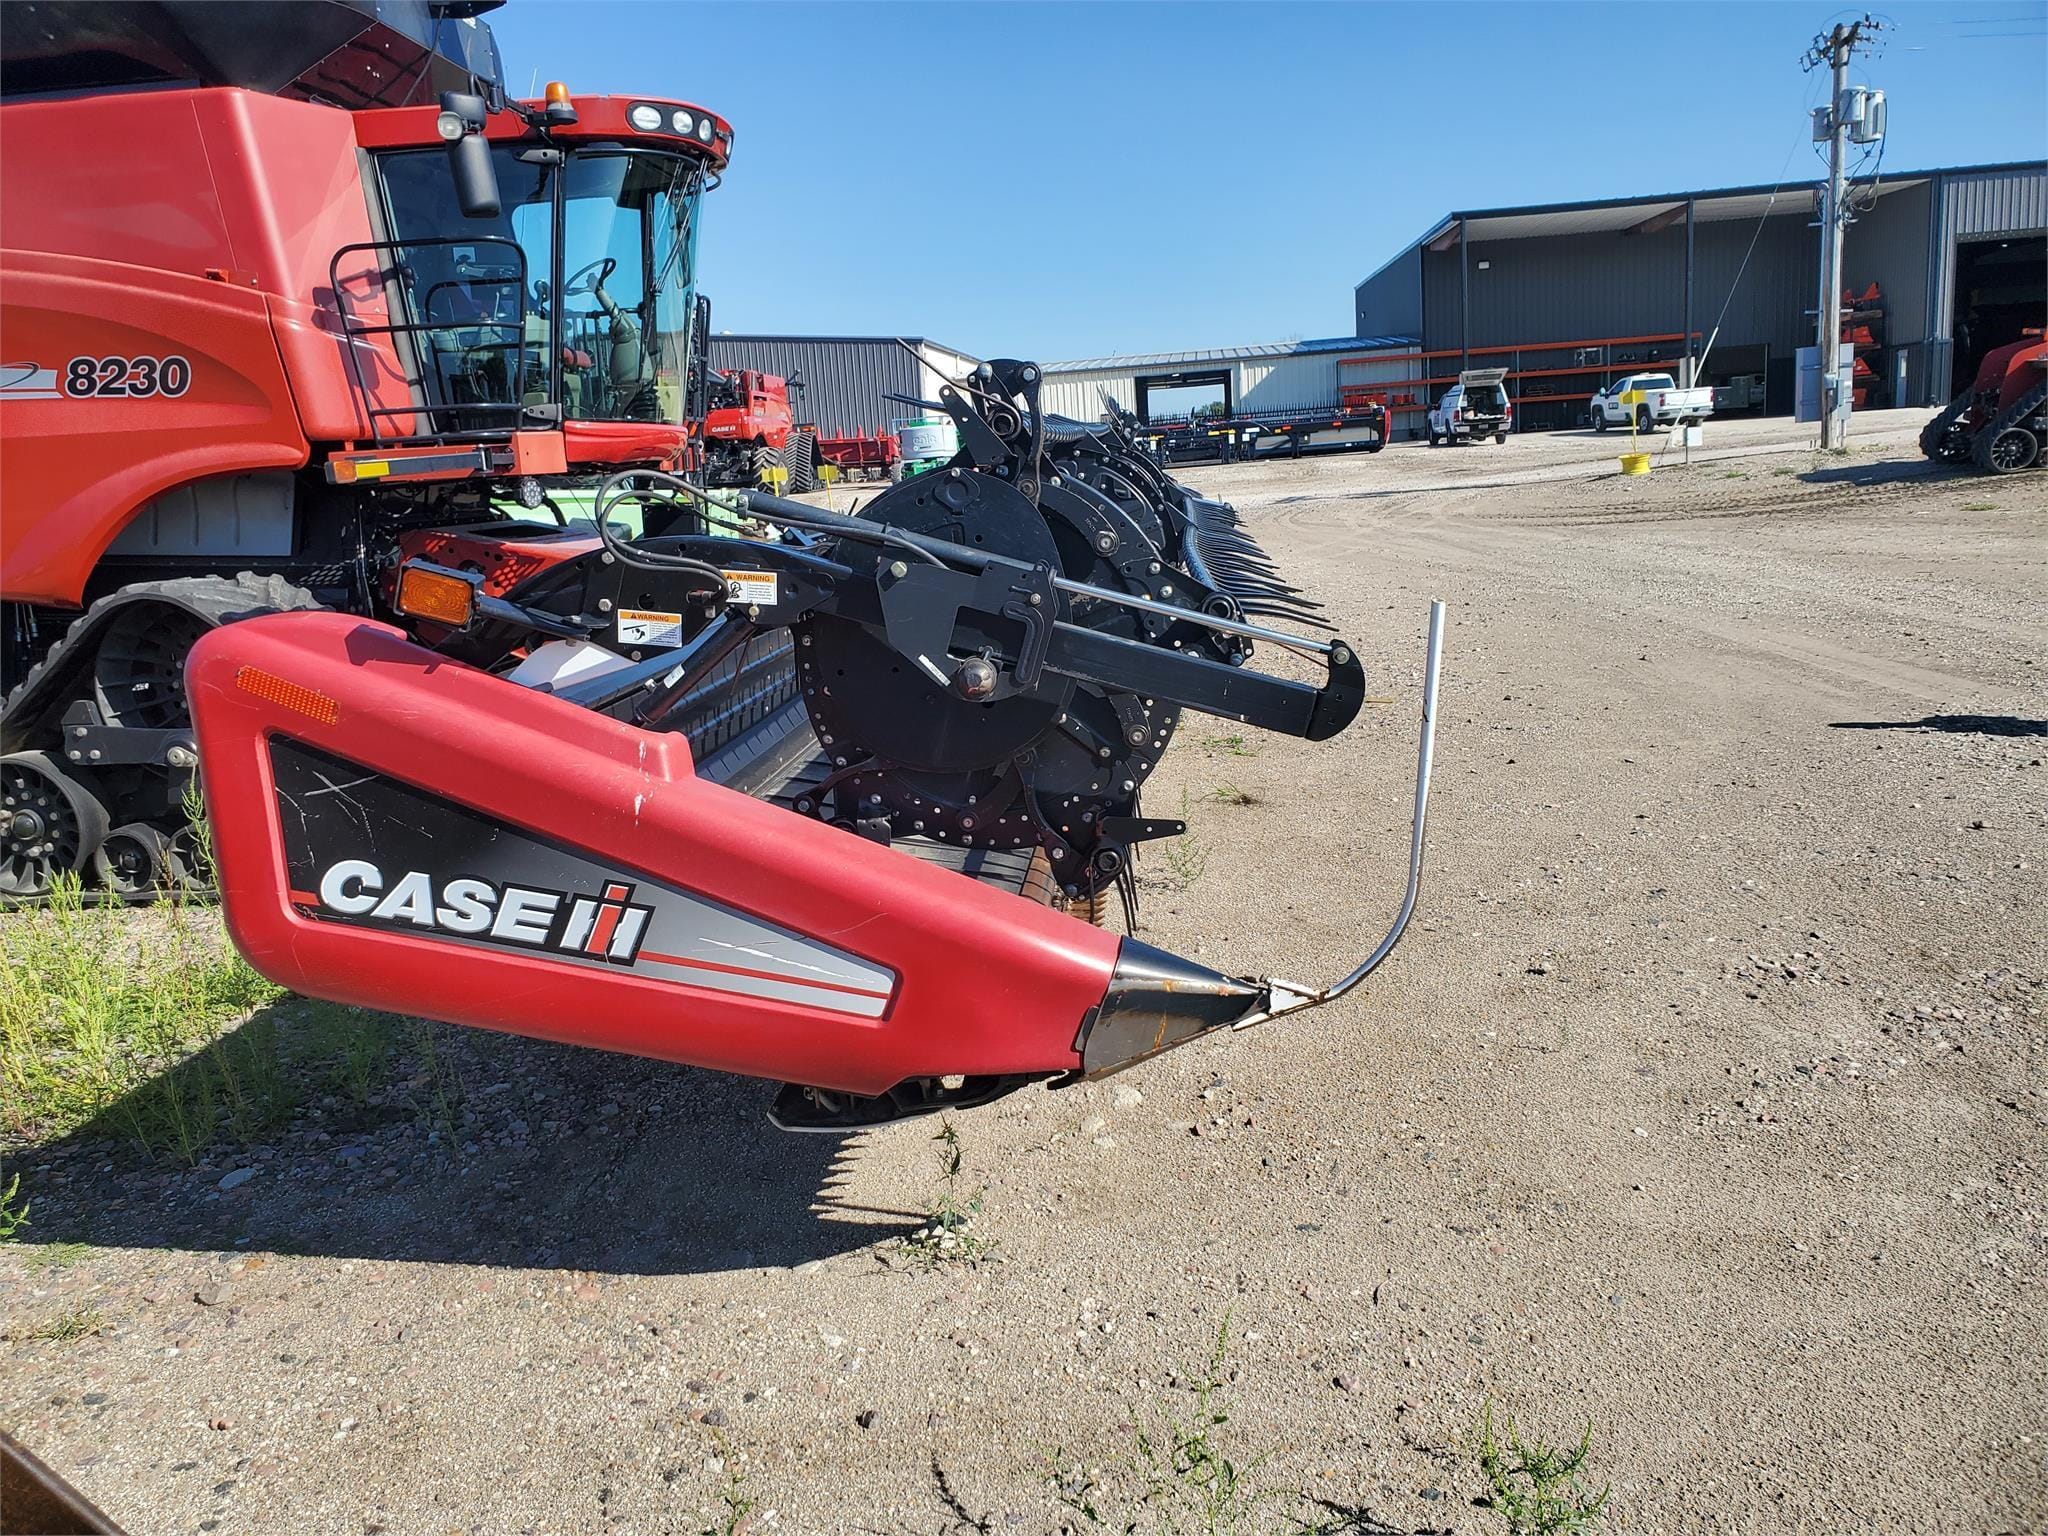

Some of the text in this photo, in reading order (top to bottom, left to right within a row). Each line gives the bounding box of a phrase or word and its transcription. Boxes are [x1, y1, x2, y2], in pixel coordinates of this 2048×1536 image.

[65, 355, 191, 399] 8230
[736, 574, 770, 582] WARNING
[637, 613, 669, 622] WARNING
[320, 859, 561, 945] CASE
